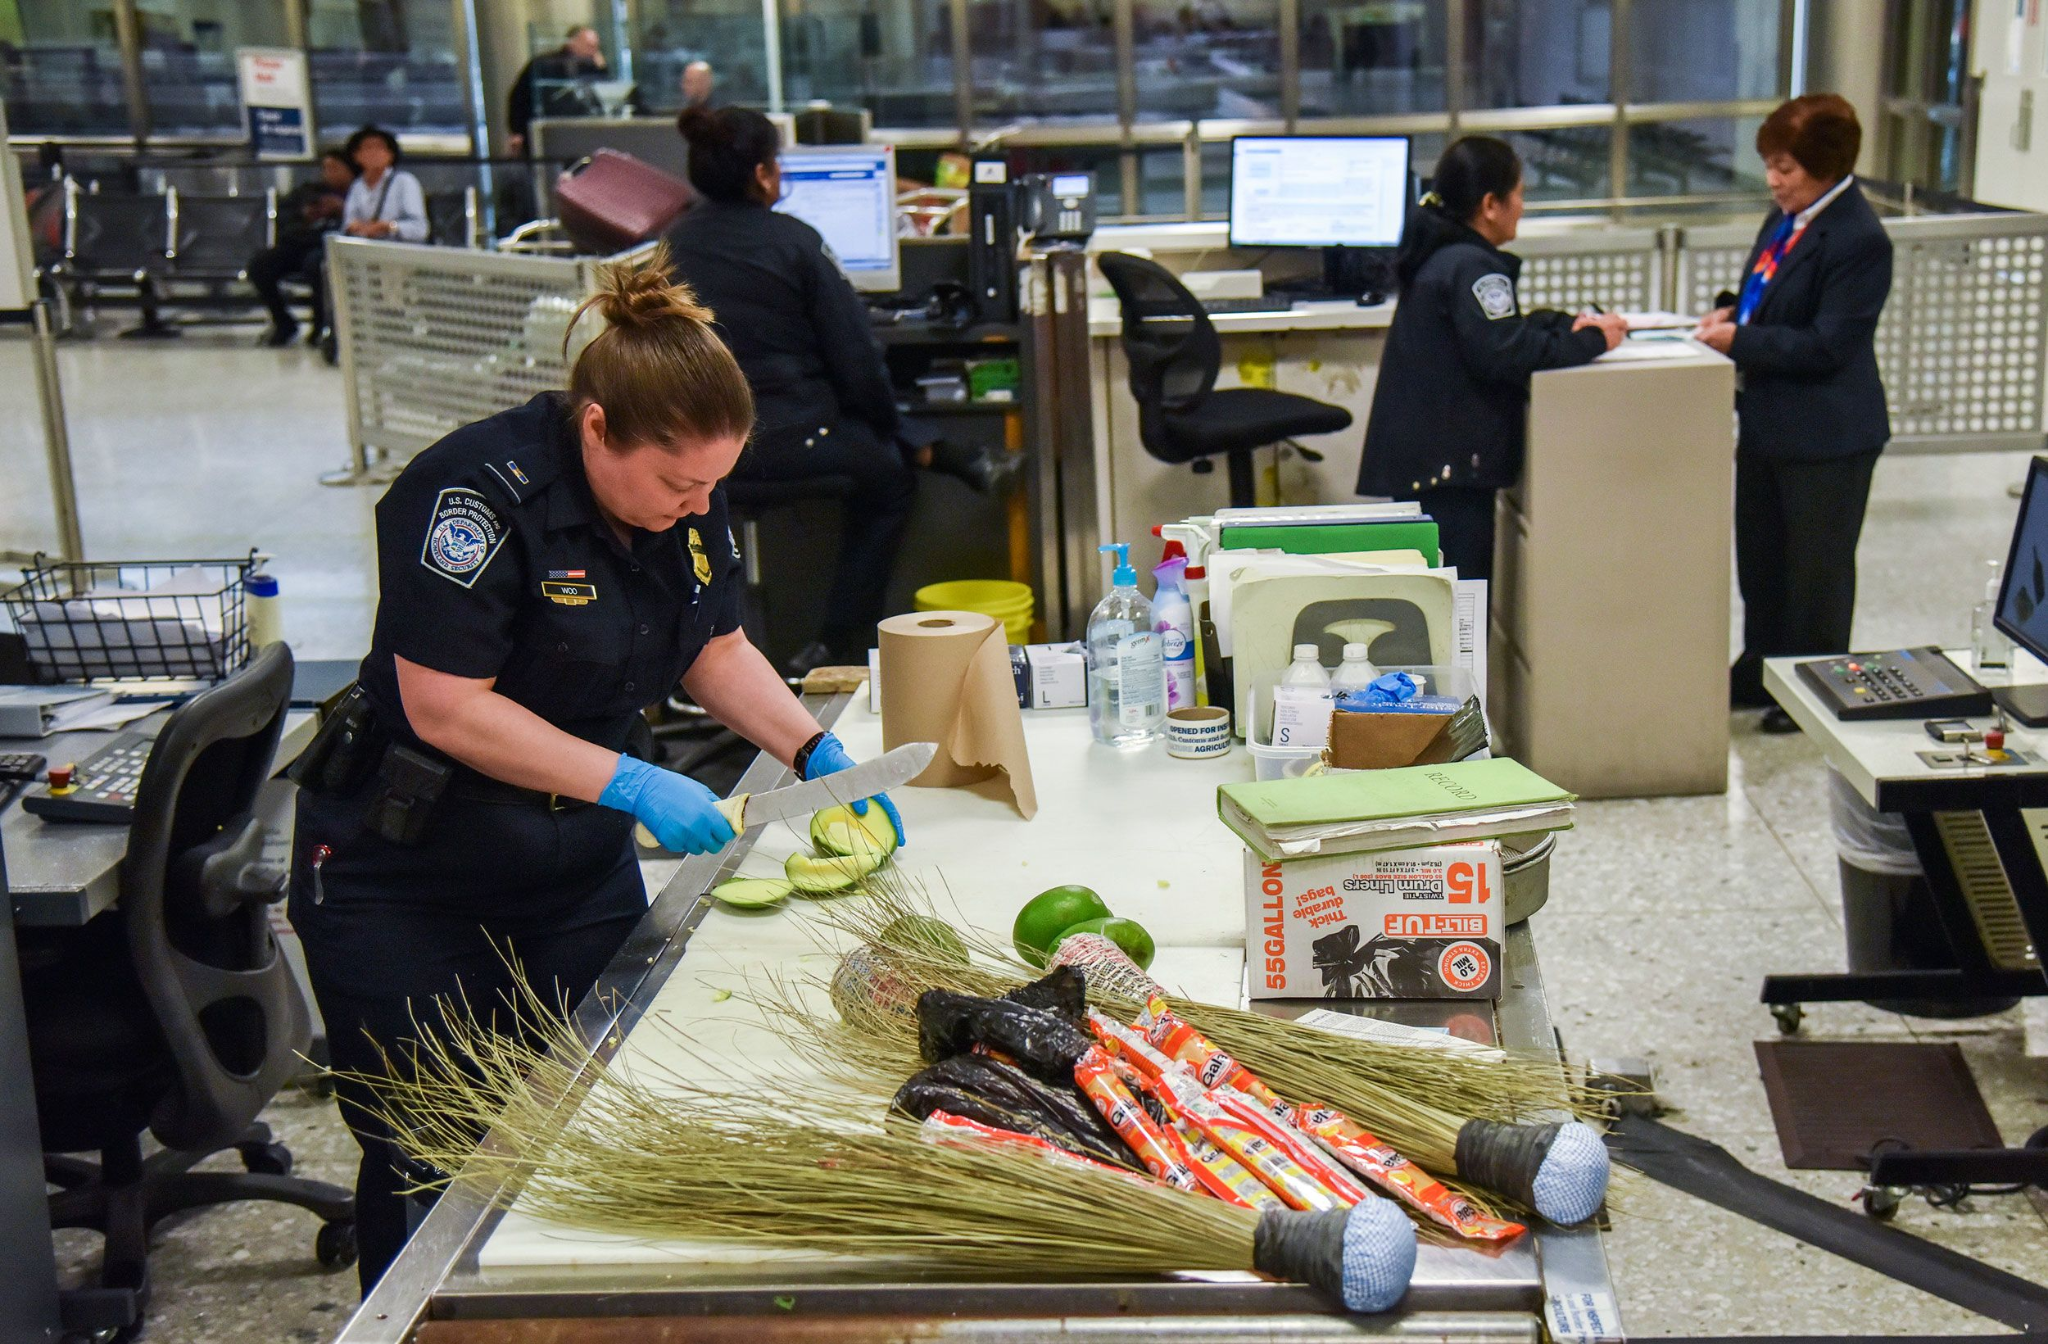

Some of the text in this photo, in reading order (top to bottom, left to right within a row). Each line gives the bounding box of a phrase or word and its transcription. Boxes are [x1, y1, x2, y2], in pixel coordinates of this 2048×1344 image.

[448, 496, 462, 505] U.S.
[464, 497, 497, 521] CUSTOMS
[438, 507, 497, 544] BORDER PROTECTION
[450, 557, 480, 571] SECURITY
[561, 587, 578, 595] WOO
[1042, 690, 1051, 704] L
[1170, 725, 1199, 735] OPENED
[1200, 726, 1216, 735] FOR
[1280, 727, 1290, 743] S
[1424, 772, 1477, 800] RECORD
[1343, 878, 1444, 894] Drum Liners
[1446, 861, 1491, 904] 15
[1296, 885, 1336, 905] bags!
[1403, 892, 1444, 900] TWIST TIE
[1292, 896, 1345, 919] durable
[1310, 909, 1348, 929] Thick
[1451, 955, 1471, 970] MIL
[1459, 962, 1477, 978] 3.0
[1201, 1052, 1230, 1086] Gala
